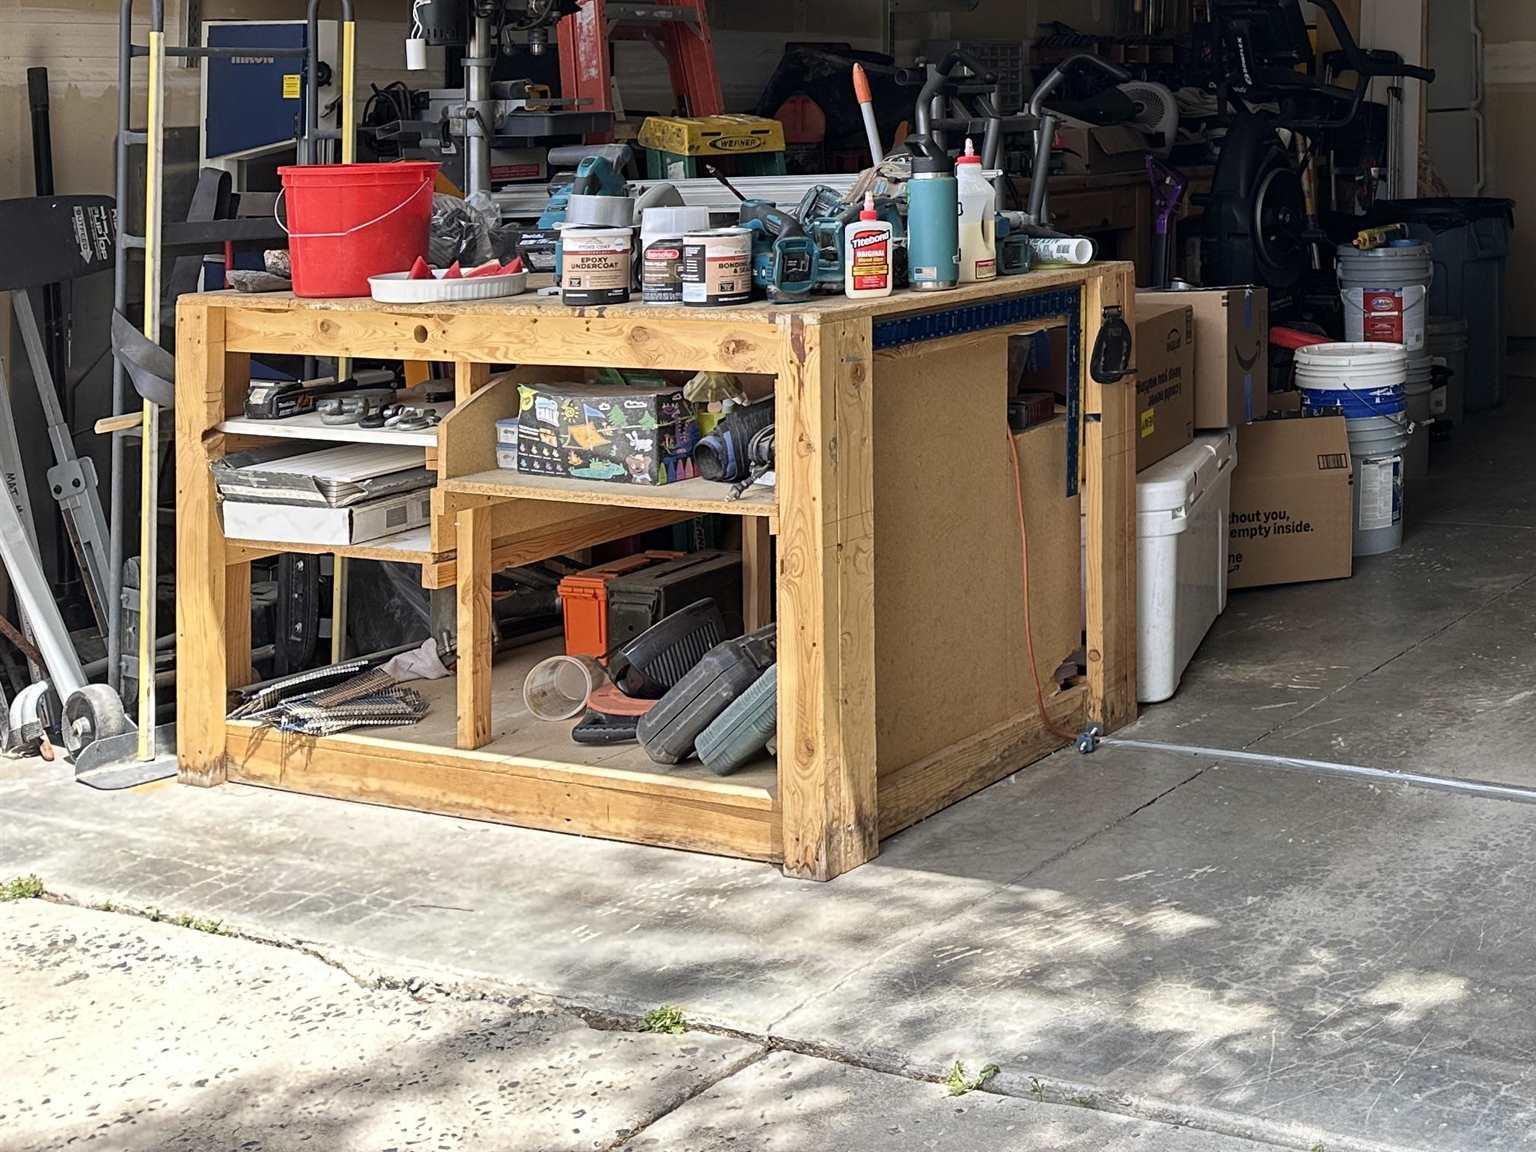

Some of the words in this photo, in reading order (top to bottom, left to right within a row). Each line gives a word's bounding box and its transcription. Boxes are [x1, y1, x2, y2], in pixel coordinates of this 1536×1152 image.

[720, 138, 757, 147] WERNER
[852, 231, 889, 248] Titebond
[580, 256, 608, 264] EPOXY
[571, 262, 618, 270] UNDERCOAT
[1229, 510, 1261, 524] hout
[1263, 510, 1290, 524] you,
[1230, 524, 1271, 539] empty
[1273, 521, 1314, 535] inside.
